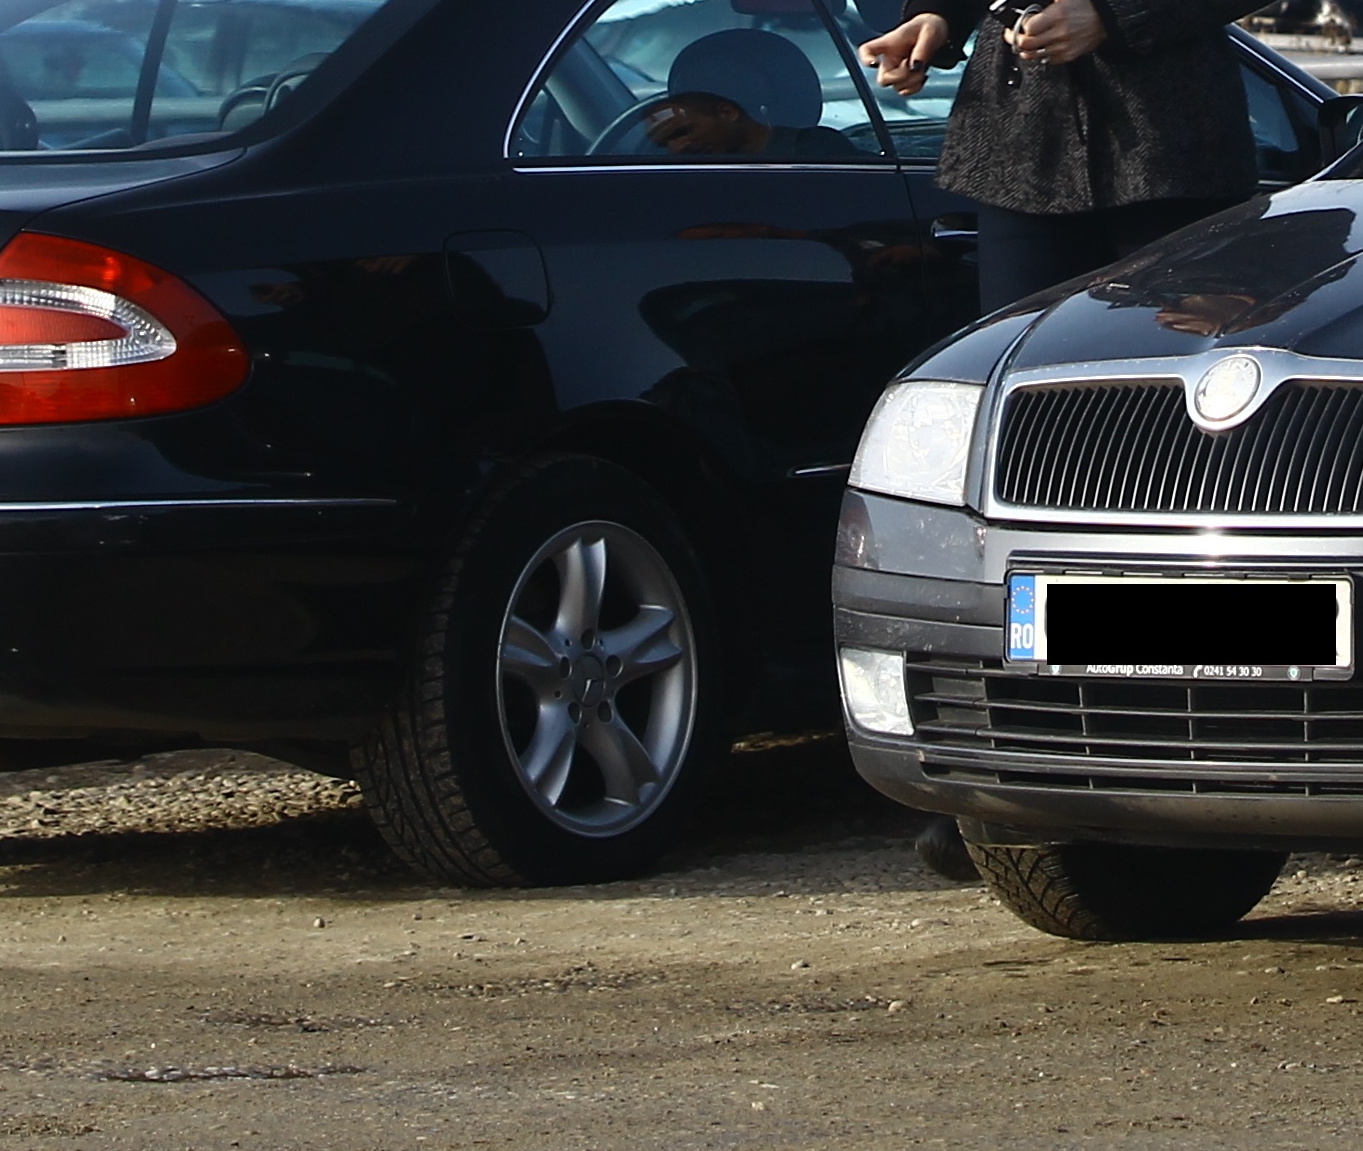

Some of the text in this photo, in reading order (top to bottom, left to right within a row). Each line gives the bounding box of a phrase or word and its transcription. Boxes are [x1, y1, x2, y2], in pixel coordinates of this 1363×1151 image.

[1010, 622, 1034, 650] RO
[1203, 665, 1224, 676] 0241
[1226, 666, 1237, 676] 54
[1239, 667, 1250, 677] 30
[1251, 667, 1263, 677] 30
